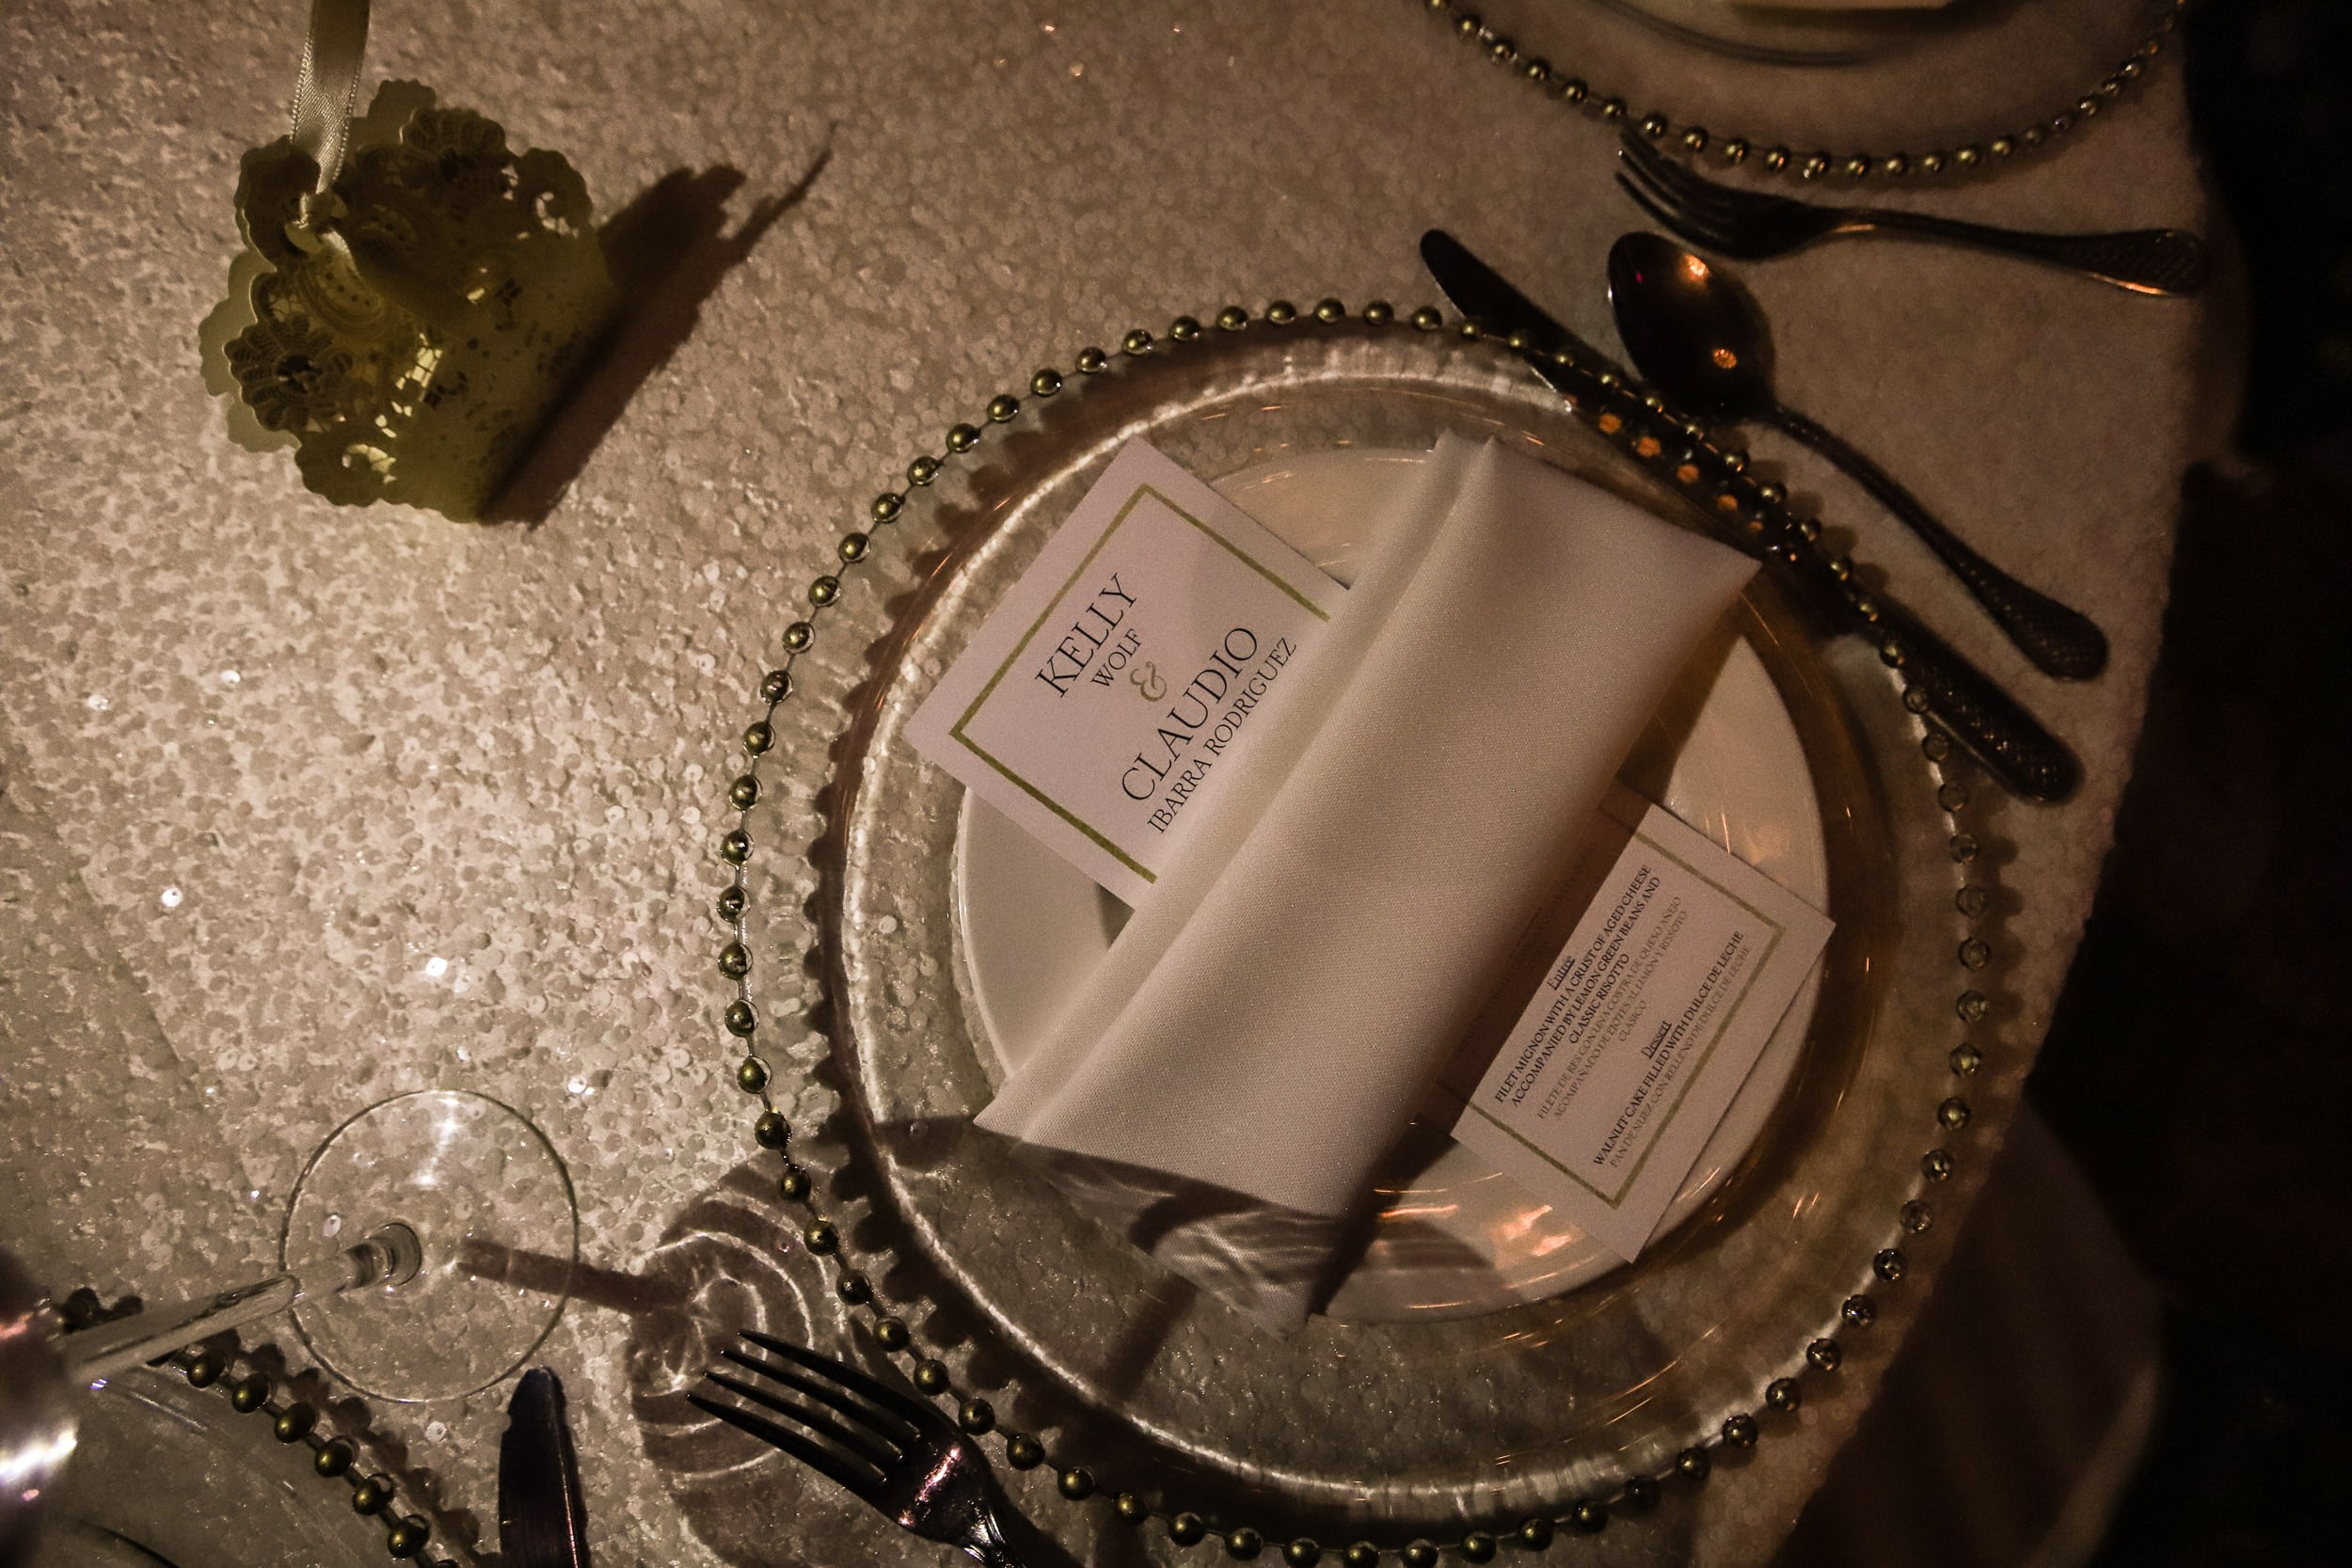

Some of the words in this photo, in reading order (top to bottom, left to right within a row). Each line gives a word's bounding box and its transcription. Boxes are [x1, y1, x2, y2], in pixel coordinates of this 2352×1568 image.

[1033, 571, 1137, 699] KELLY
[1089, 626, 1142, 687] WOLF
[1120, 626, 1258, 800] CLAUDIO
[1128, 659, 1166, 702] &
[1145, 758, 1213, 834] IBARRA
[1201, 636, 1296, 756] RODRIGUEZ
[1493, 1069, 1520, 1103] FILET
[1512, 1022, 1550, 1074] MIGNON
[1542, 993, 1569, 1026] WITH
[1567, 947, 1597, 988] CRUST
[1599, 903, 1627, 937] AGED
[1618, 863, 1652, 907] CHEESE
[1508, 1022, 1568, 1107] ACCOMPANIED
[1570, 969, 1602, 1011] LEMON
[1595, 933, 1625, 973] GREEN
[1618, 899, 1646, 937] BEANS
[1639, 876, 1662, 903] AND
[1535, 1085, 1563, 1119] FILETE
[1565, 1053, 1583, 1074] RES
[1576, 1031, 1597, 1057] CON
[1591, 1008, 1612, 1034] UNA
[1605, 972, 1635, 1012] COSTRA
[1637, 925, 1665, 960] QUESO
[1566, 997, 1601, 1045] CLASSIC
[1595, 951, 1631, 1001] RISOTTO
[1593, 1115, 1630, 1166] WALNUT
[1623, 1085, 1649, 1118] CAKE
[1642, 1047, 1672, 1088] FILLED
[1664, 1019, 1690, 1051] WITH
[1683, 981, 1713, 1022] DULCE
[1716, 929, 1745, 969] LECHE
[1609, 1144, 1629, 1168] PAN
[1631, 1101, 1655, 1132] NUEZ
[1648, 1079, 1669, 1104] CON
[1662, 1035, 1695, 1082] RELLENO
[1697, 988, 1725, 1024] DULCE
[1725, 943, 1752, 978] LECHE
[1639, 1017, 1672, 1059] Dessert
